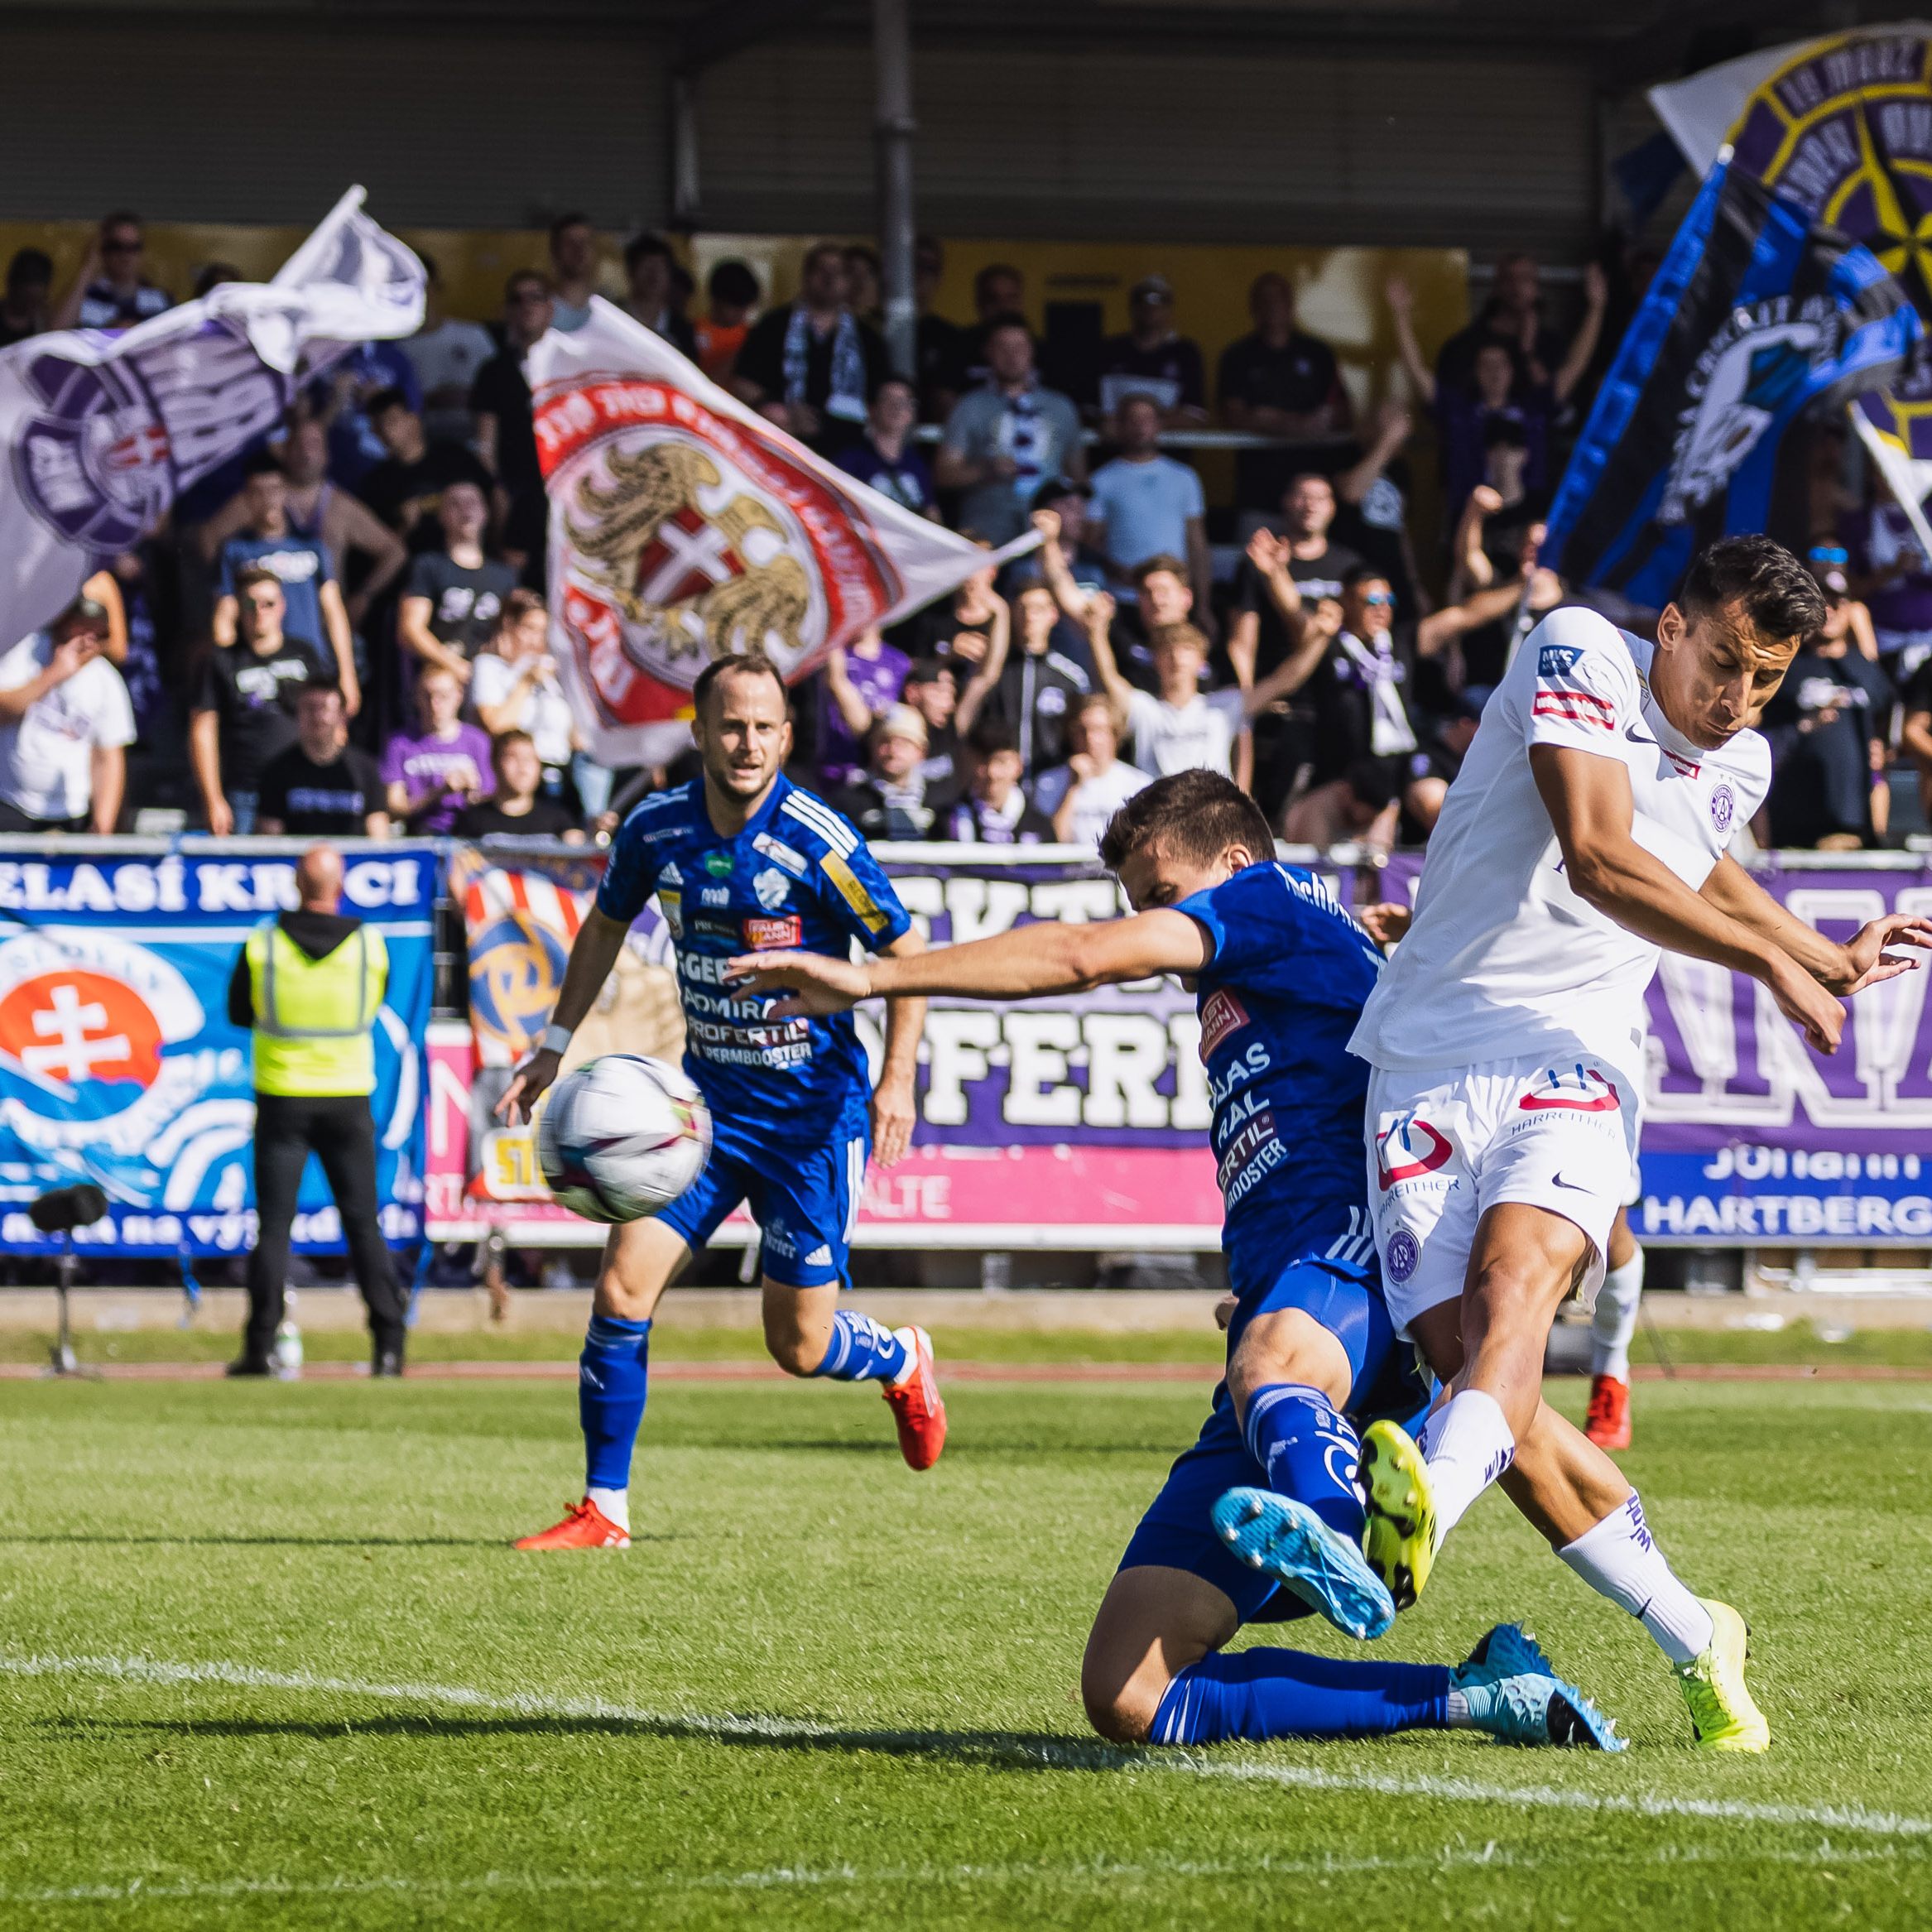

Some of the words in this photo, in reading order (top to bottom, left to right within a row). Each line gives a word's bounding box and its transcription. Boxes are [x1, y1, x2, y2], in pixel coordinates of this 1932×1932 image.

[193, 861, 420, 911] KRCI
[1218, 1089, 1271, 1149] RAL
[1511, 1112, 1616, 1140] HARREITHER
[1218, 1121, 1274, 1190] ERTIL
[1642, 1194, 1932, 1236] HARTBERG
